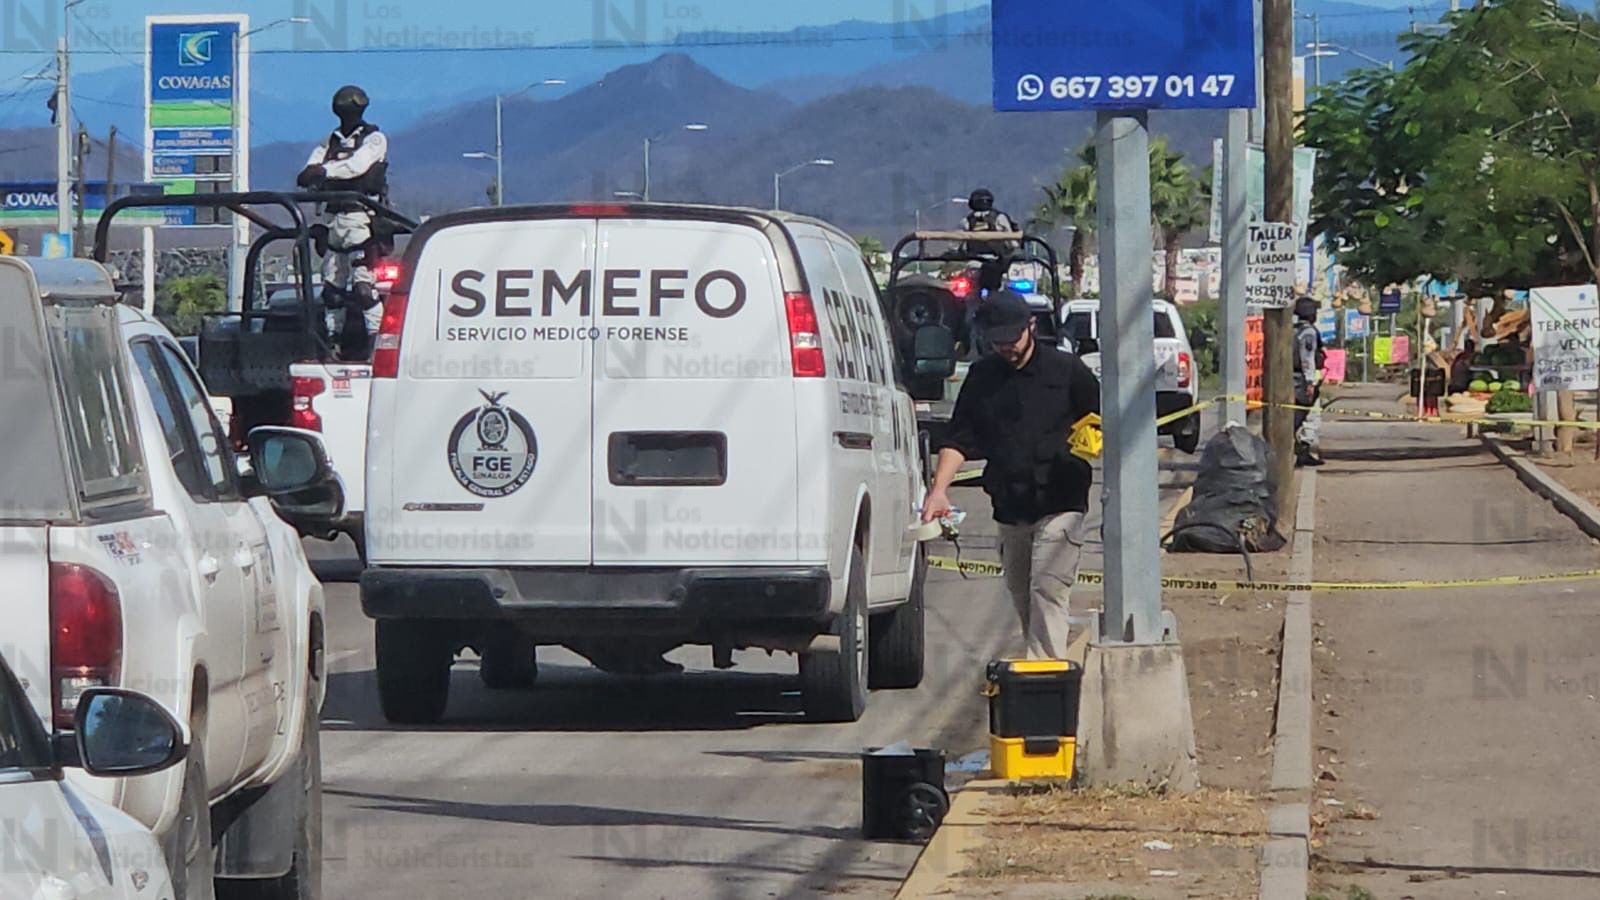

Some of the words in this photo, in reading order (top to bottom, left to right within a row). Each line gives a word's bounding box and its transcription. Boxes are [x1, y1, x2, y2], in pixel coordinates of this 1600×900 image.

[158, 75, 232, 89] COVAGAS
[1050, 76, 1102, 98] 667
[1108, 75, 1158, 98] 397
[1165, 75, 1195, 97] 01
[1201, 74, 1236, 96] 47
[1248, 226, 1293, 242] TALLER
[1260, 241, 1277, 252] DE
[448, 268, 748, 319] SEMEFO
[446, 326, 527, 341] SERVICIO
[533, 326, 600, 341] MEDICO
[607, 326, 689, 341] FORENSE
[472, 455, 513, 472] FGE
